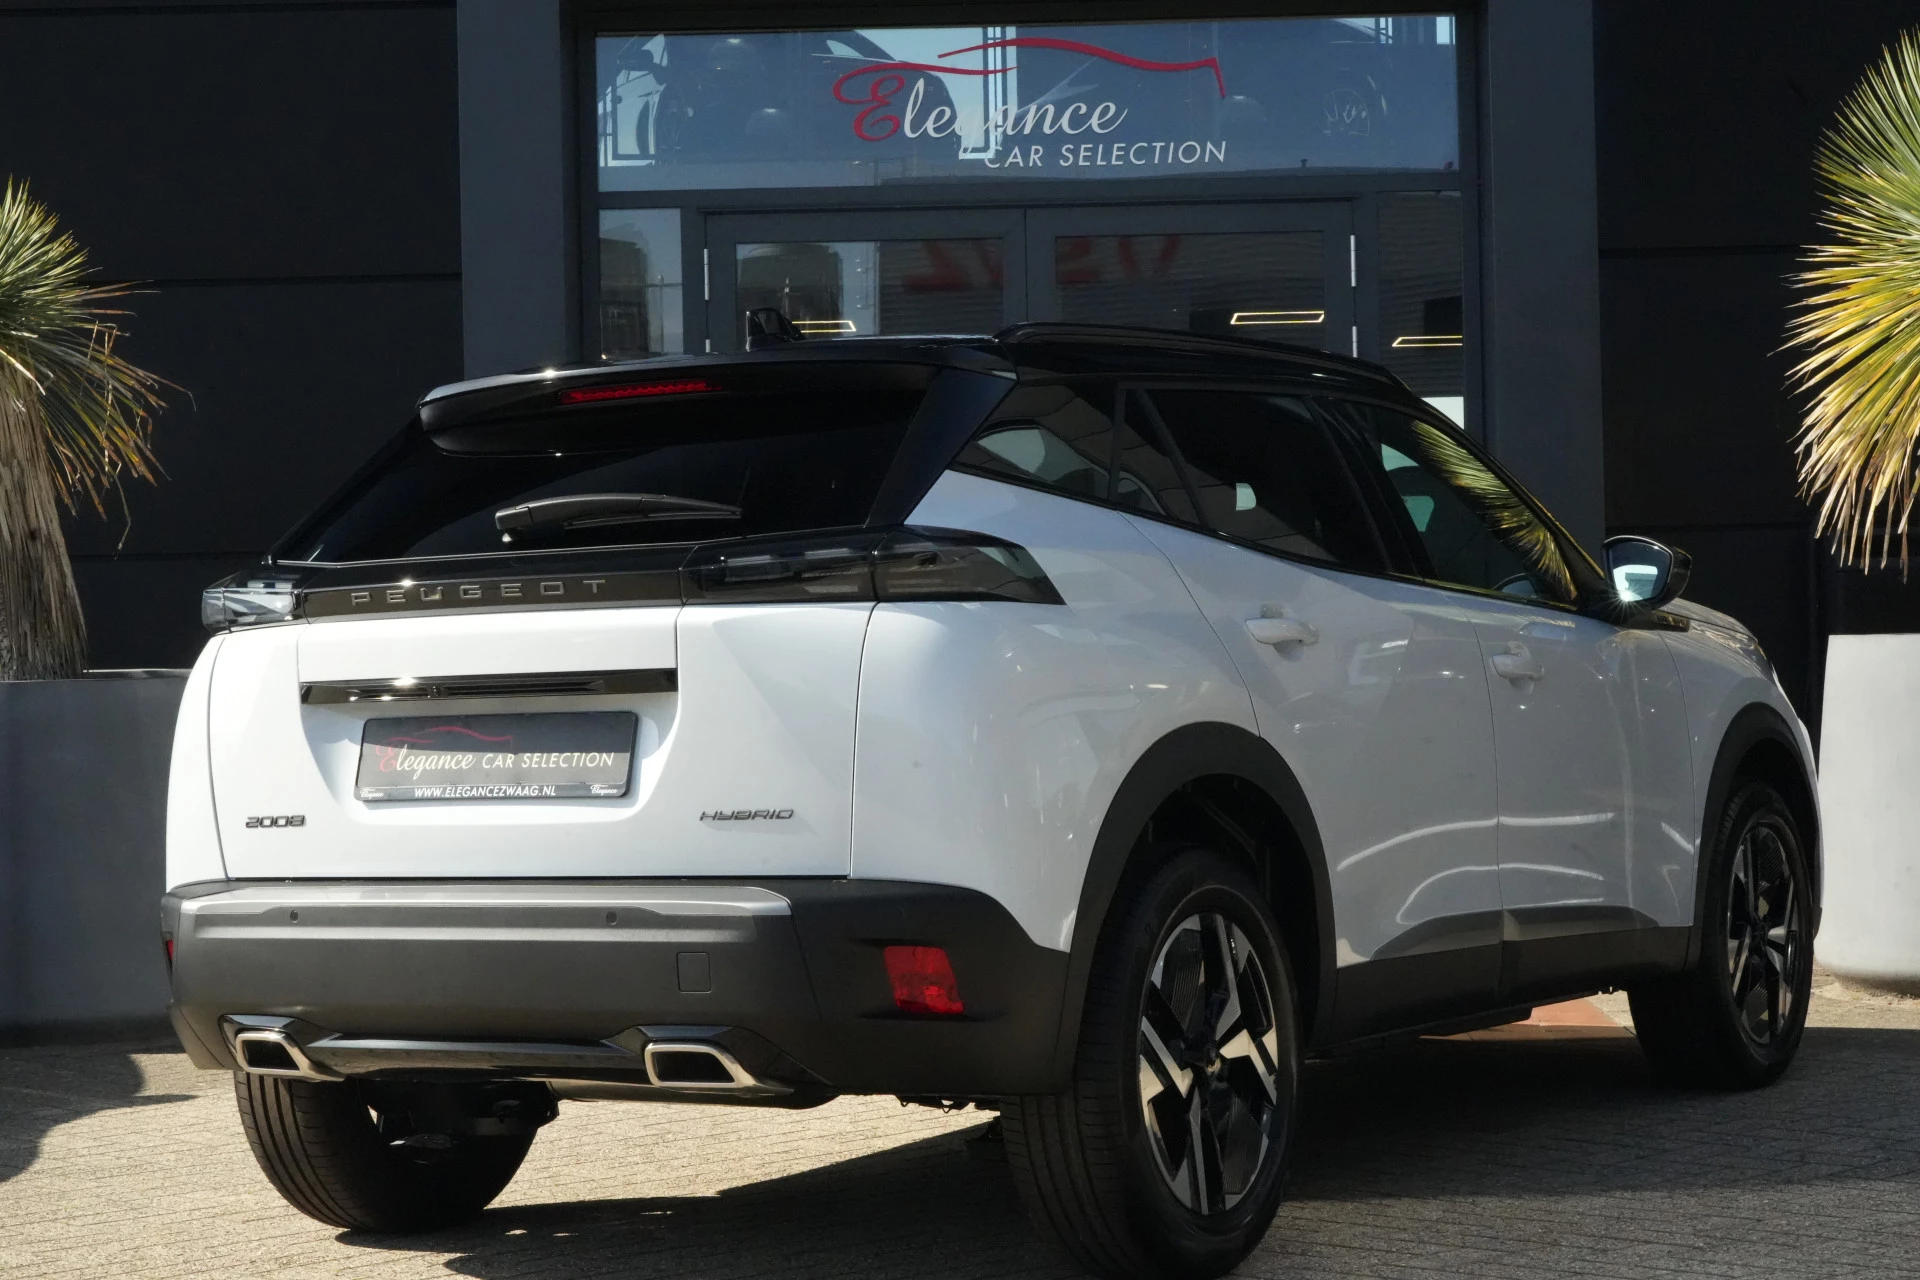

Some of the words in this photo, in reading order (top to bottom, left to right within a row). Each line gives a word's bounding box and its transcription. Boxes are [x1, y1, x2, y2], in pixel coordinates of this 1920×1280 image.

[833, 66, 1127, 159] Elegance
[1060, 141, 1227, 166] SELECTION
[351, 579, 606, 606] PEUGEOT
[376, 743, 476, 779] Elegance
[482, 753, 513, 769] CAR
[521, 752, 615, 768] SELECTION
[414, 785, 556, 798] WWW.ELEGANCEZWAAG.NL
[245, 815, 306, 828] 2008
[699, 809, 794, 821] HYBRID
